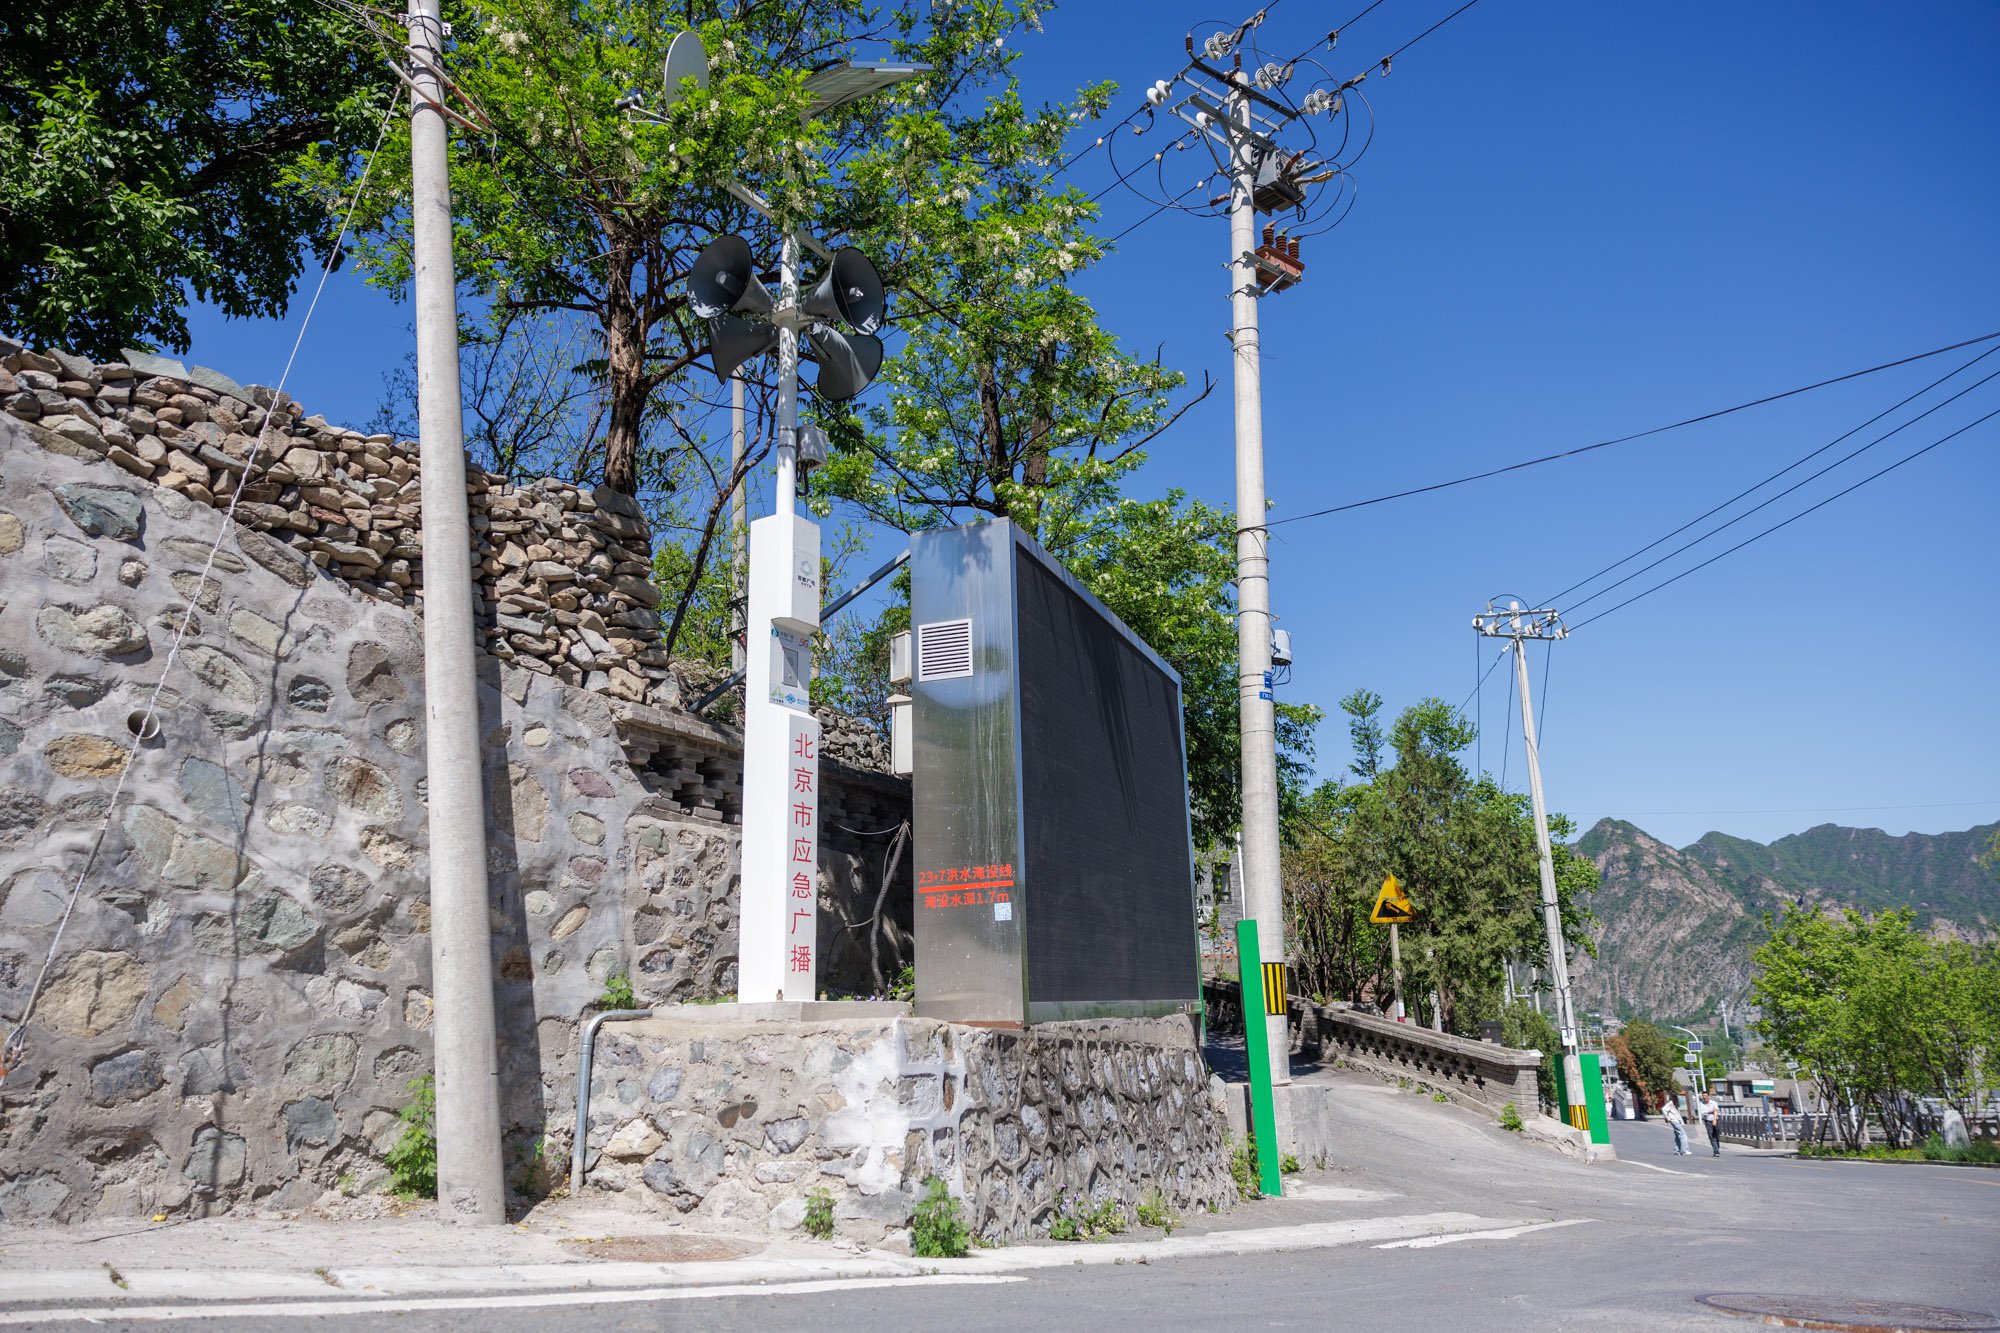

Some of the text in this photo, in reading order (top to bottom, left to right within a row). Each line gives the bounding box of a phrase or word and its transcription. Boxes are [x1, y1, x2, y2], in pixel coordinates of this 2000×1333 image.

[790, 732, 815, 973] 北京市应急广播
